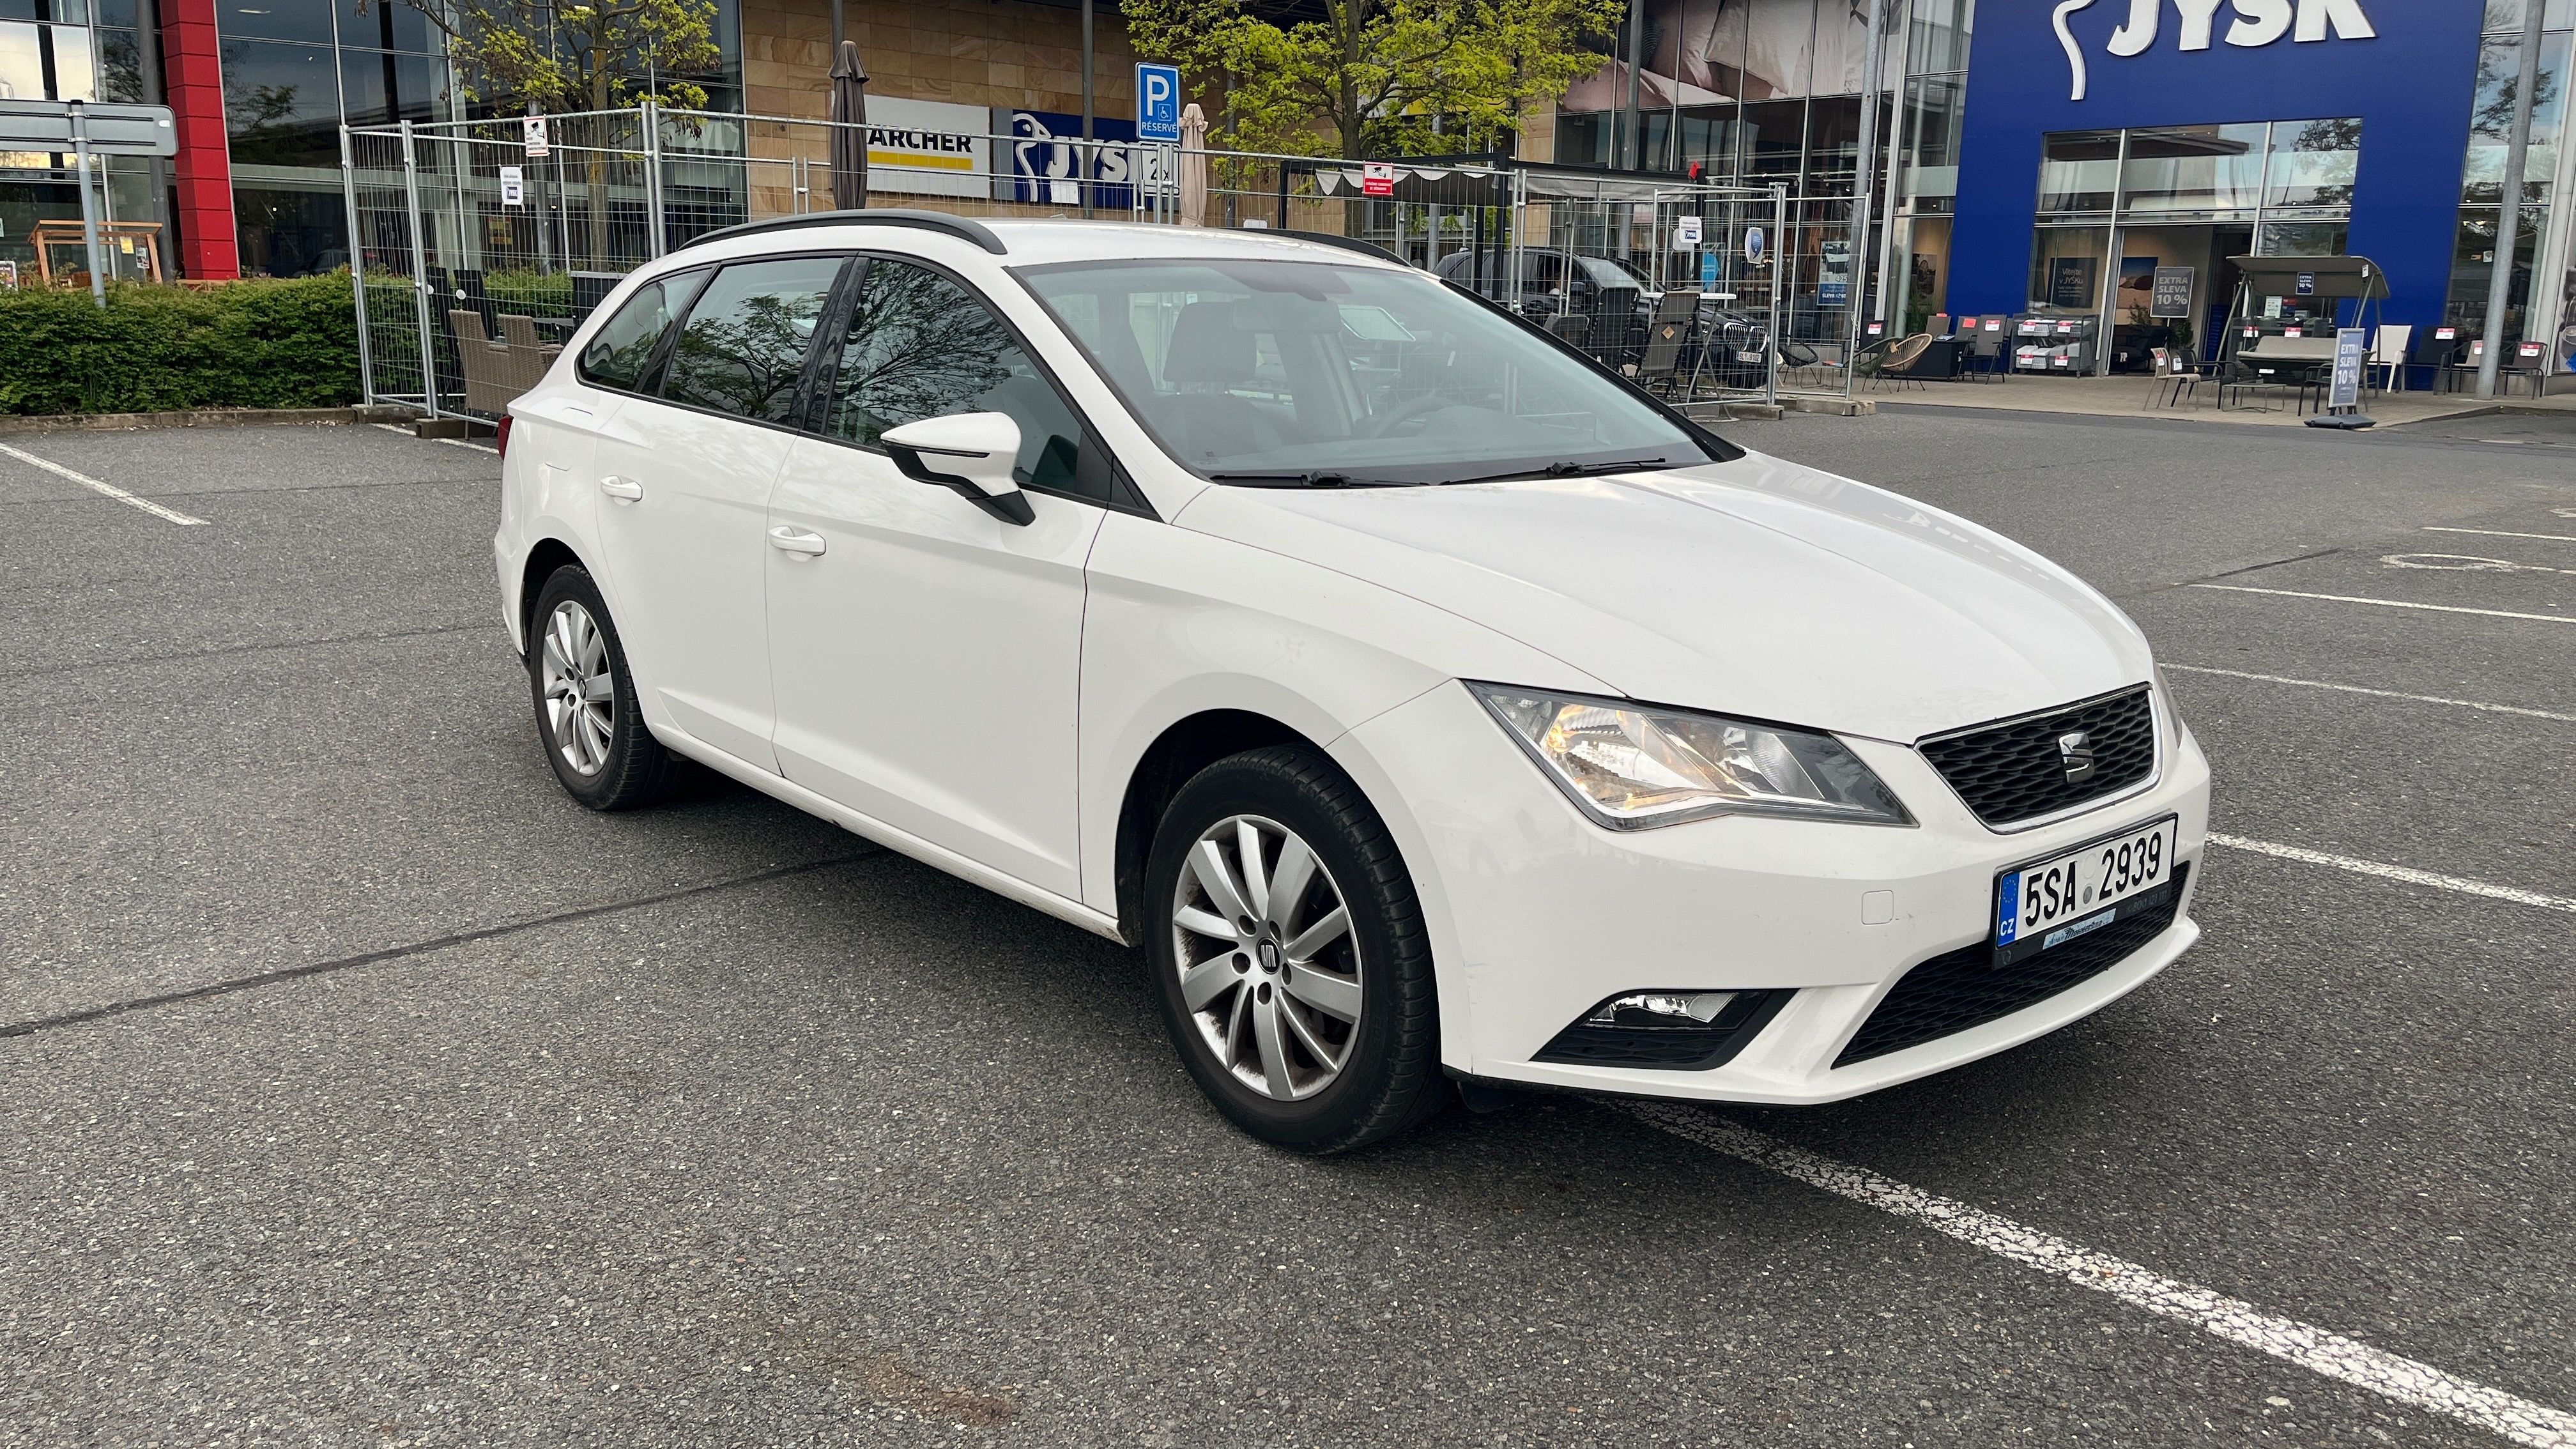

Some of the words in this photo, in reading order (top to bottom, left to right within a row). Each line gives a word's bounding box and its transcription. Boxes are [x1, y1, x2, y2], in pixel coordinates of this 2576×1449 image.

[2107, 0, 2377, 56] JYSK
[1147, 74, 1170, 116] P
[1142, 120, 1177, 133] RÉSERVÉ
[868, 125, 972, 153] ARCHER
[2156, 295, 2172, 305] 10
[2174, 294, 2188, 305] %
[2340, 344, 2359, 355] EXTRA
[2340, 356, 2357, 367] SLEVA
[2338, 370, 2348, 385] 10
[2349, 369, 2356, 385] %
[2025, 861, 2077, 926] 5SA
[2099, 831, 2161, 901] 2939
[2000, 917, 2014, 937] CZ
